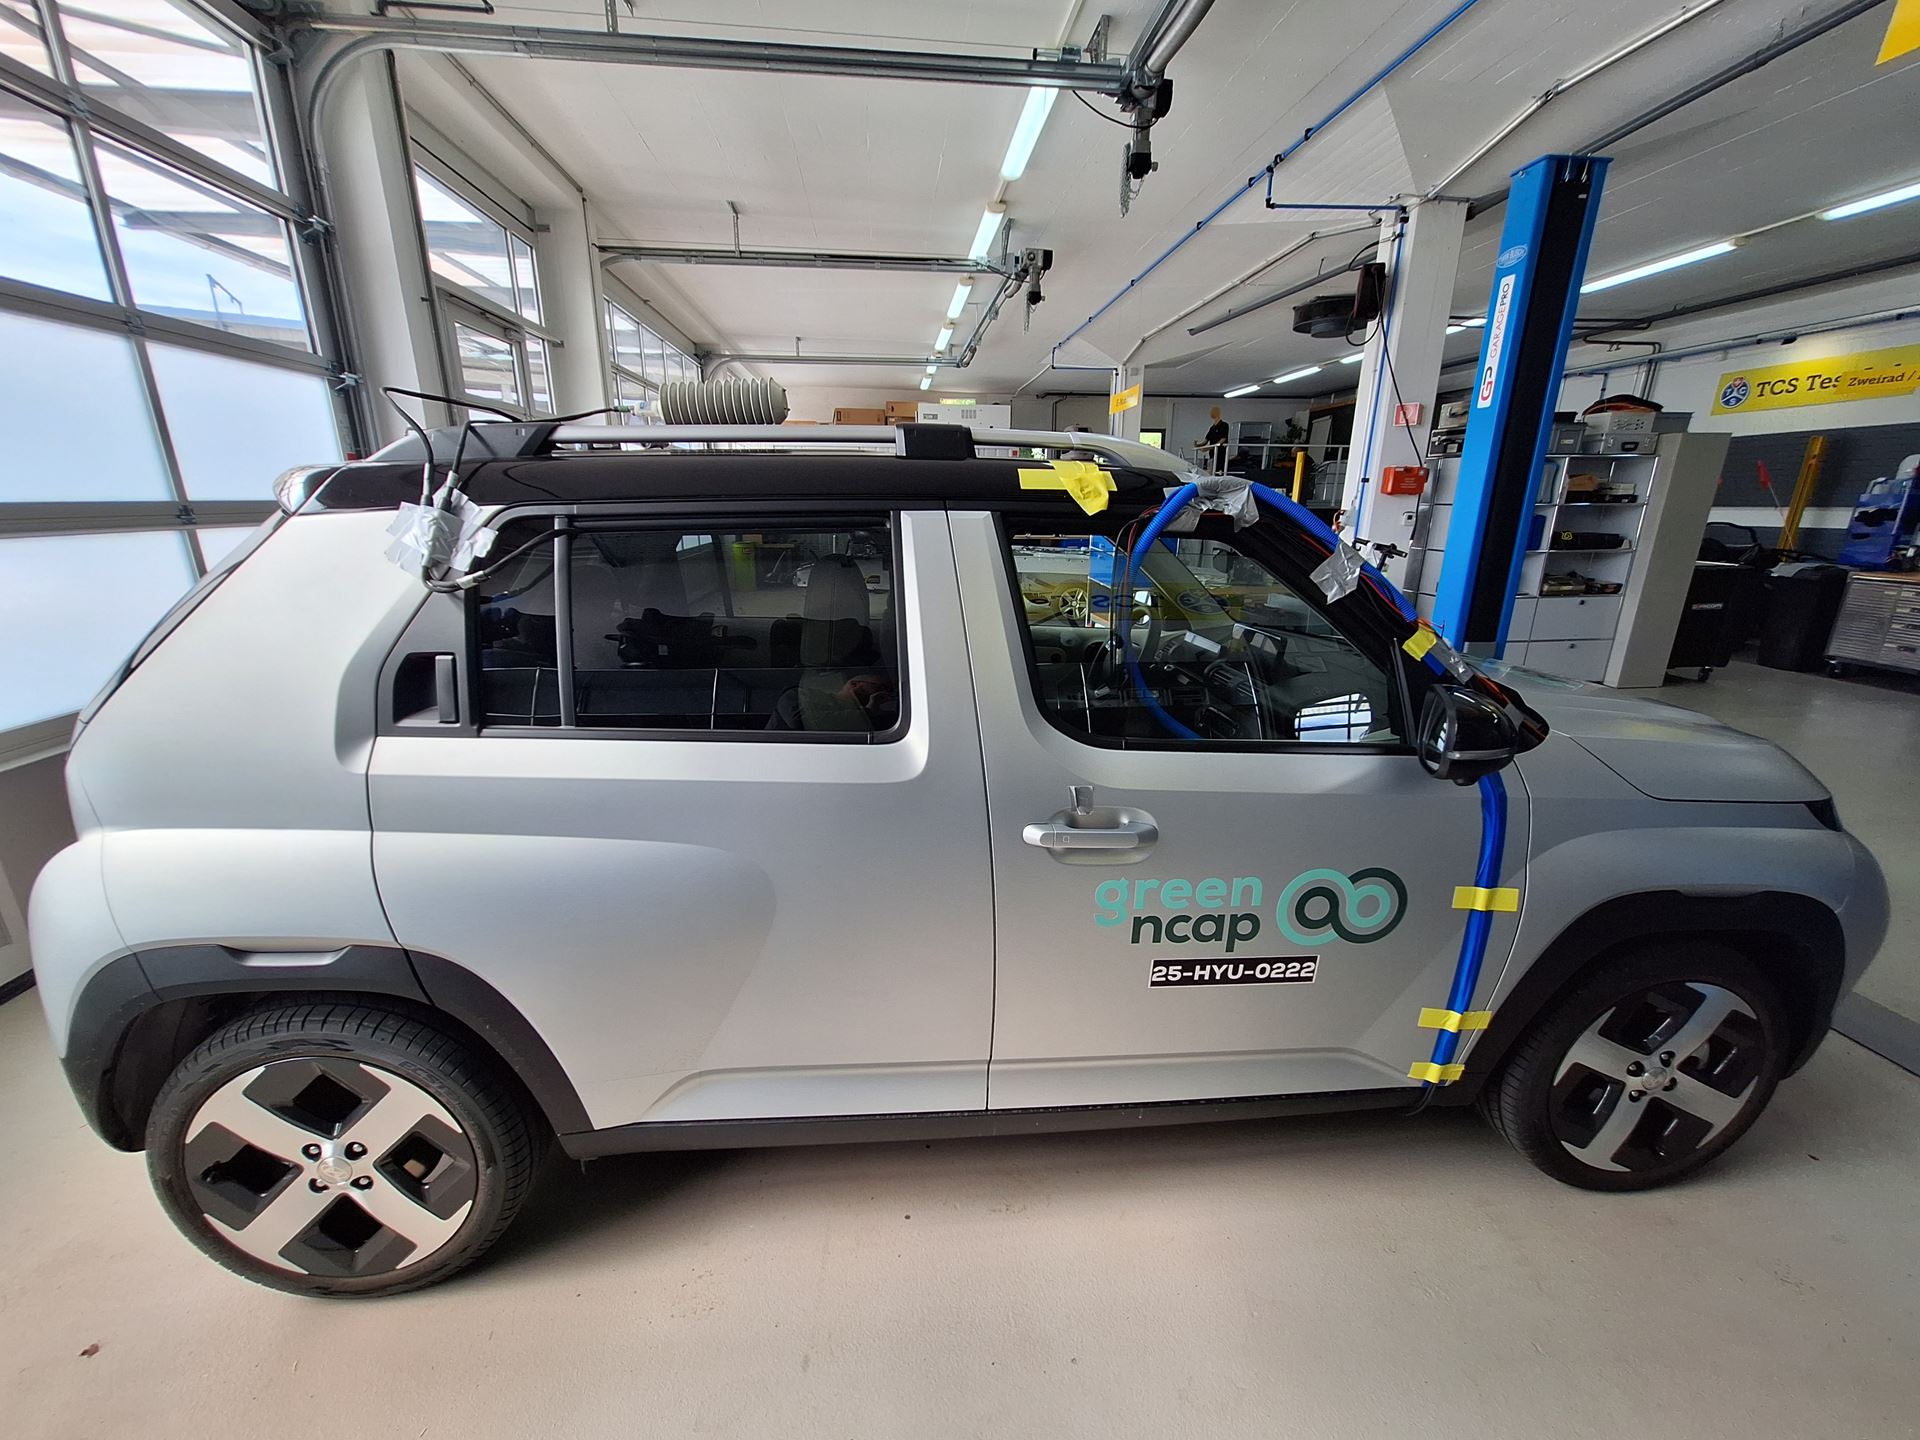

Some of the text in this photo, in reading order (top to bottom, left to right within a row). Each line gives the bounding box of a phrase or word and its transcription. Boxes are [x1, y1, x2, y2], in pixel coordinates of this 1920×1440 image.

[1490, 283, 1509, 358] GARAGEPRO
[1757, 378, 1799, 397] TCS
[1848, 371, 1905, 386] Zweirad
[1095, 876, 1264, 927] green
[1131, 912, 1261, 953] ncap
[1151, 961, 1316, 982] 25-HYU-0222
